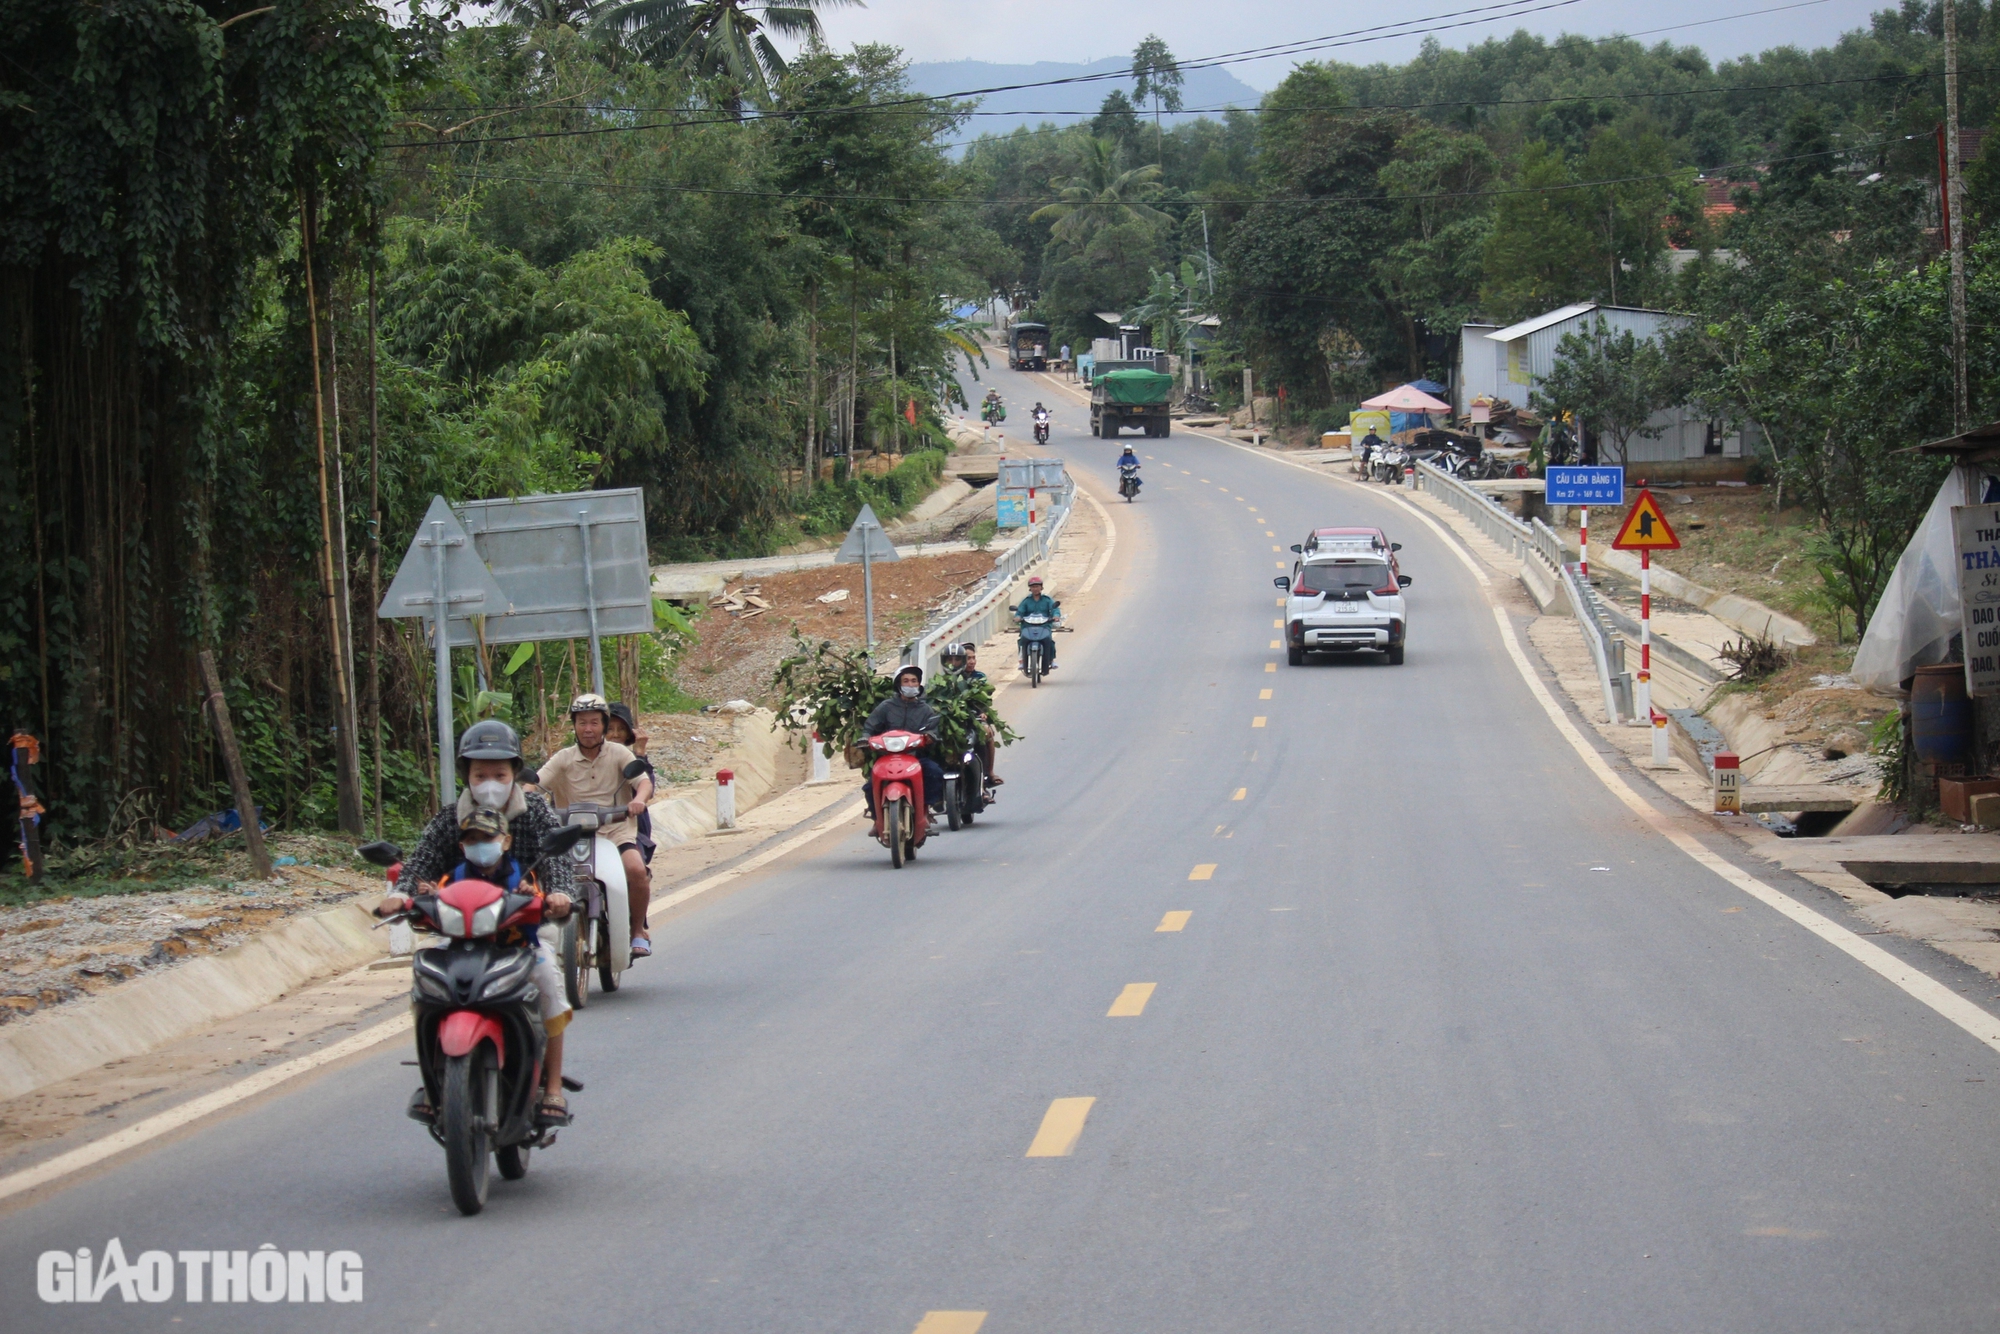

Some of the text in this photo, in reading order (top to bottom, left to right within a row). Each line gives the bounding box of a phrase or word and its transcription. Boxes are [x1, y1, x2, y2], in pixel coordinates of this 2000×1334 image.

[1556, 472, 1570, 484] CẦU
[1612, 475, 1616, 484] 1
[1973, 608, 1994, 624] DAO
[1978, 625, 2000, 647] CUỐ
[1720, 774, 1735, 786] H1
[1722, 796, 1734, 806] 27
